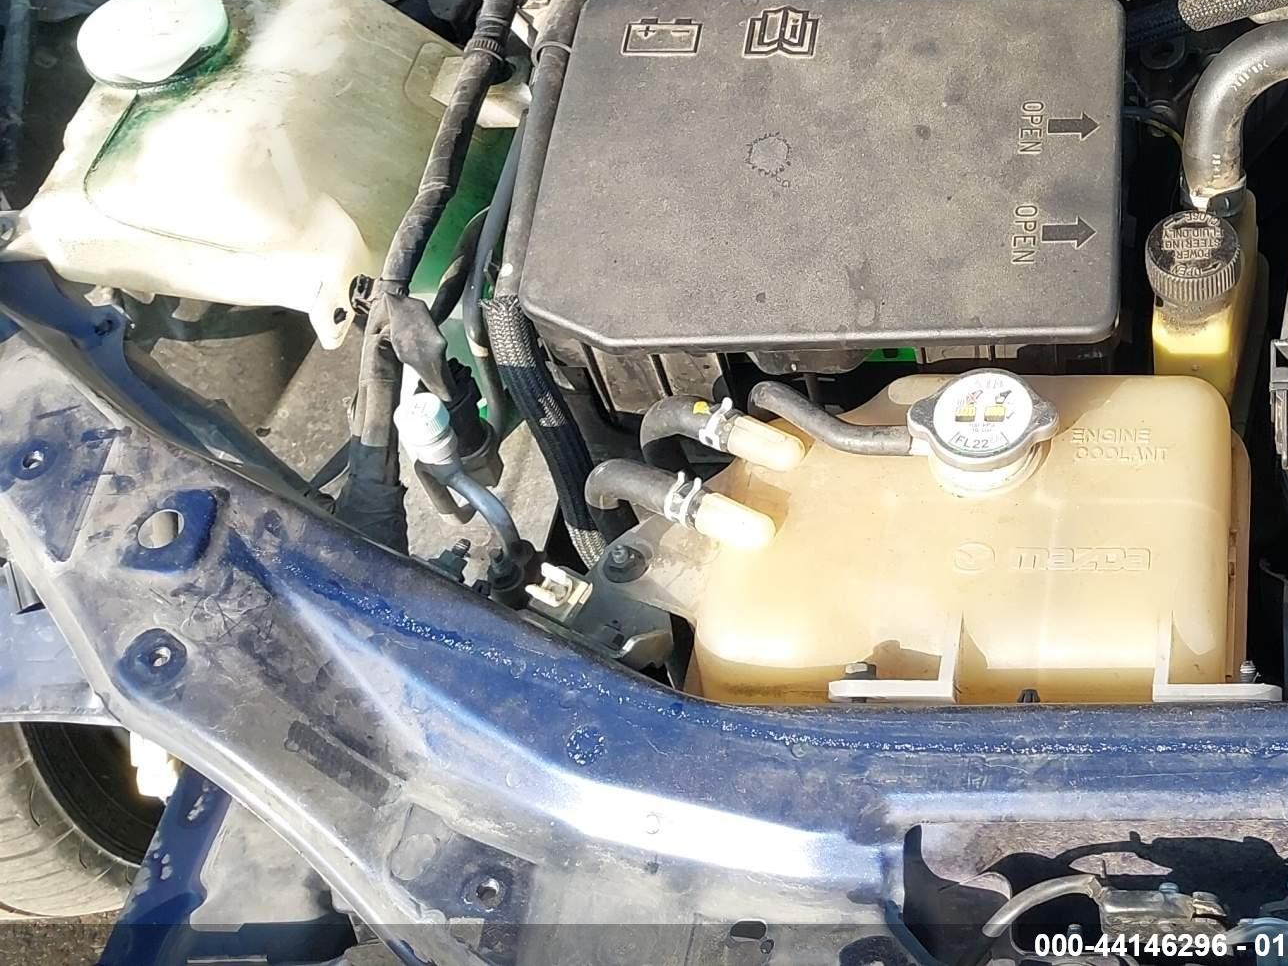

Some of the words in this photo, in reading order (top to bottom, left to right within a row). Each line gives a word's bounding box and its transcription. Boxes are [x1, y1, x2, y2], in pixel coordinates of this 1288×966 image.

[1019, 102, 1045, 153] OPEN
[1184, 213, 1219, 227] CLOSE
[1012, 205, 1038, 263] OPEN
[1163, 229, 1189, 239] ONLY
[1192, 228, 1222, 238] FLUID
[1164, 238, 1221, 249] STEERING
[1176, 249, 1211, 260] POWER
[1170, 265, 1202, 276] OPEN
[955, 435, 990, 449] FL22
[1071, 427, 1152, 443] ENGINE
[1075, 445, 1169, 461] COOLANT
